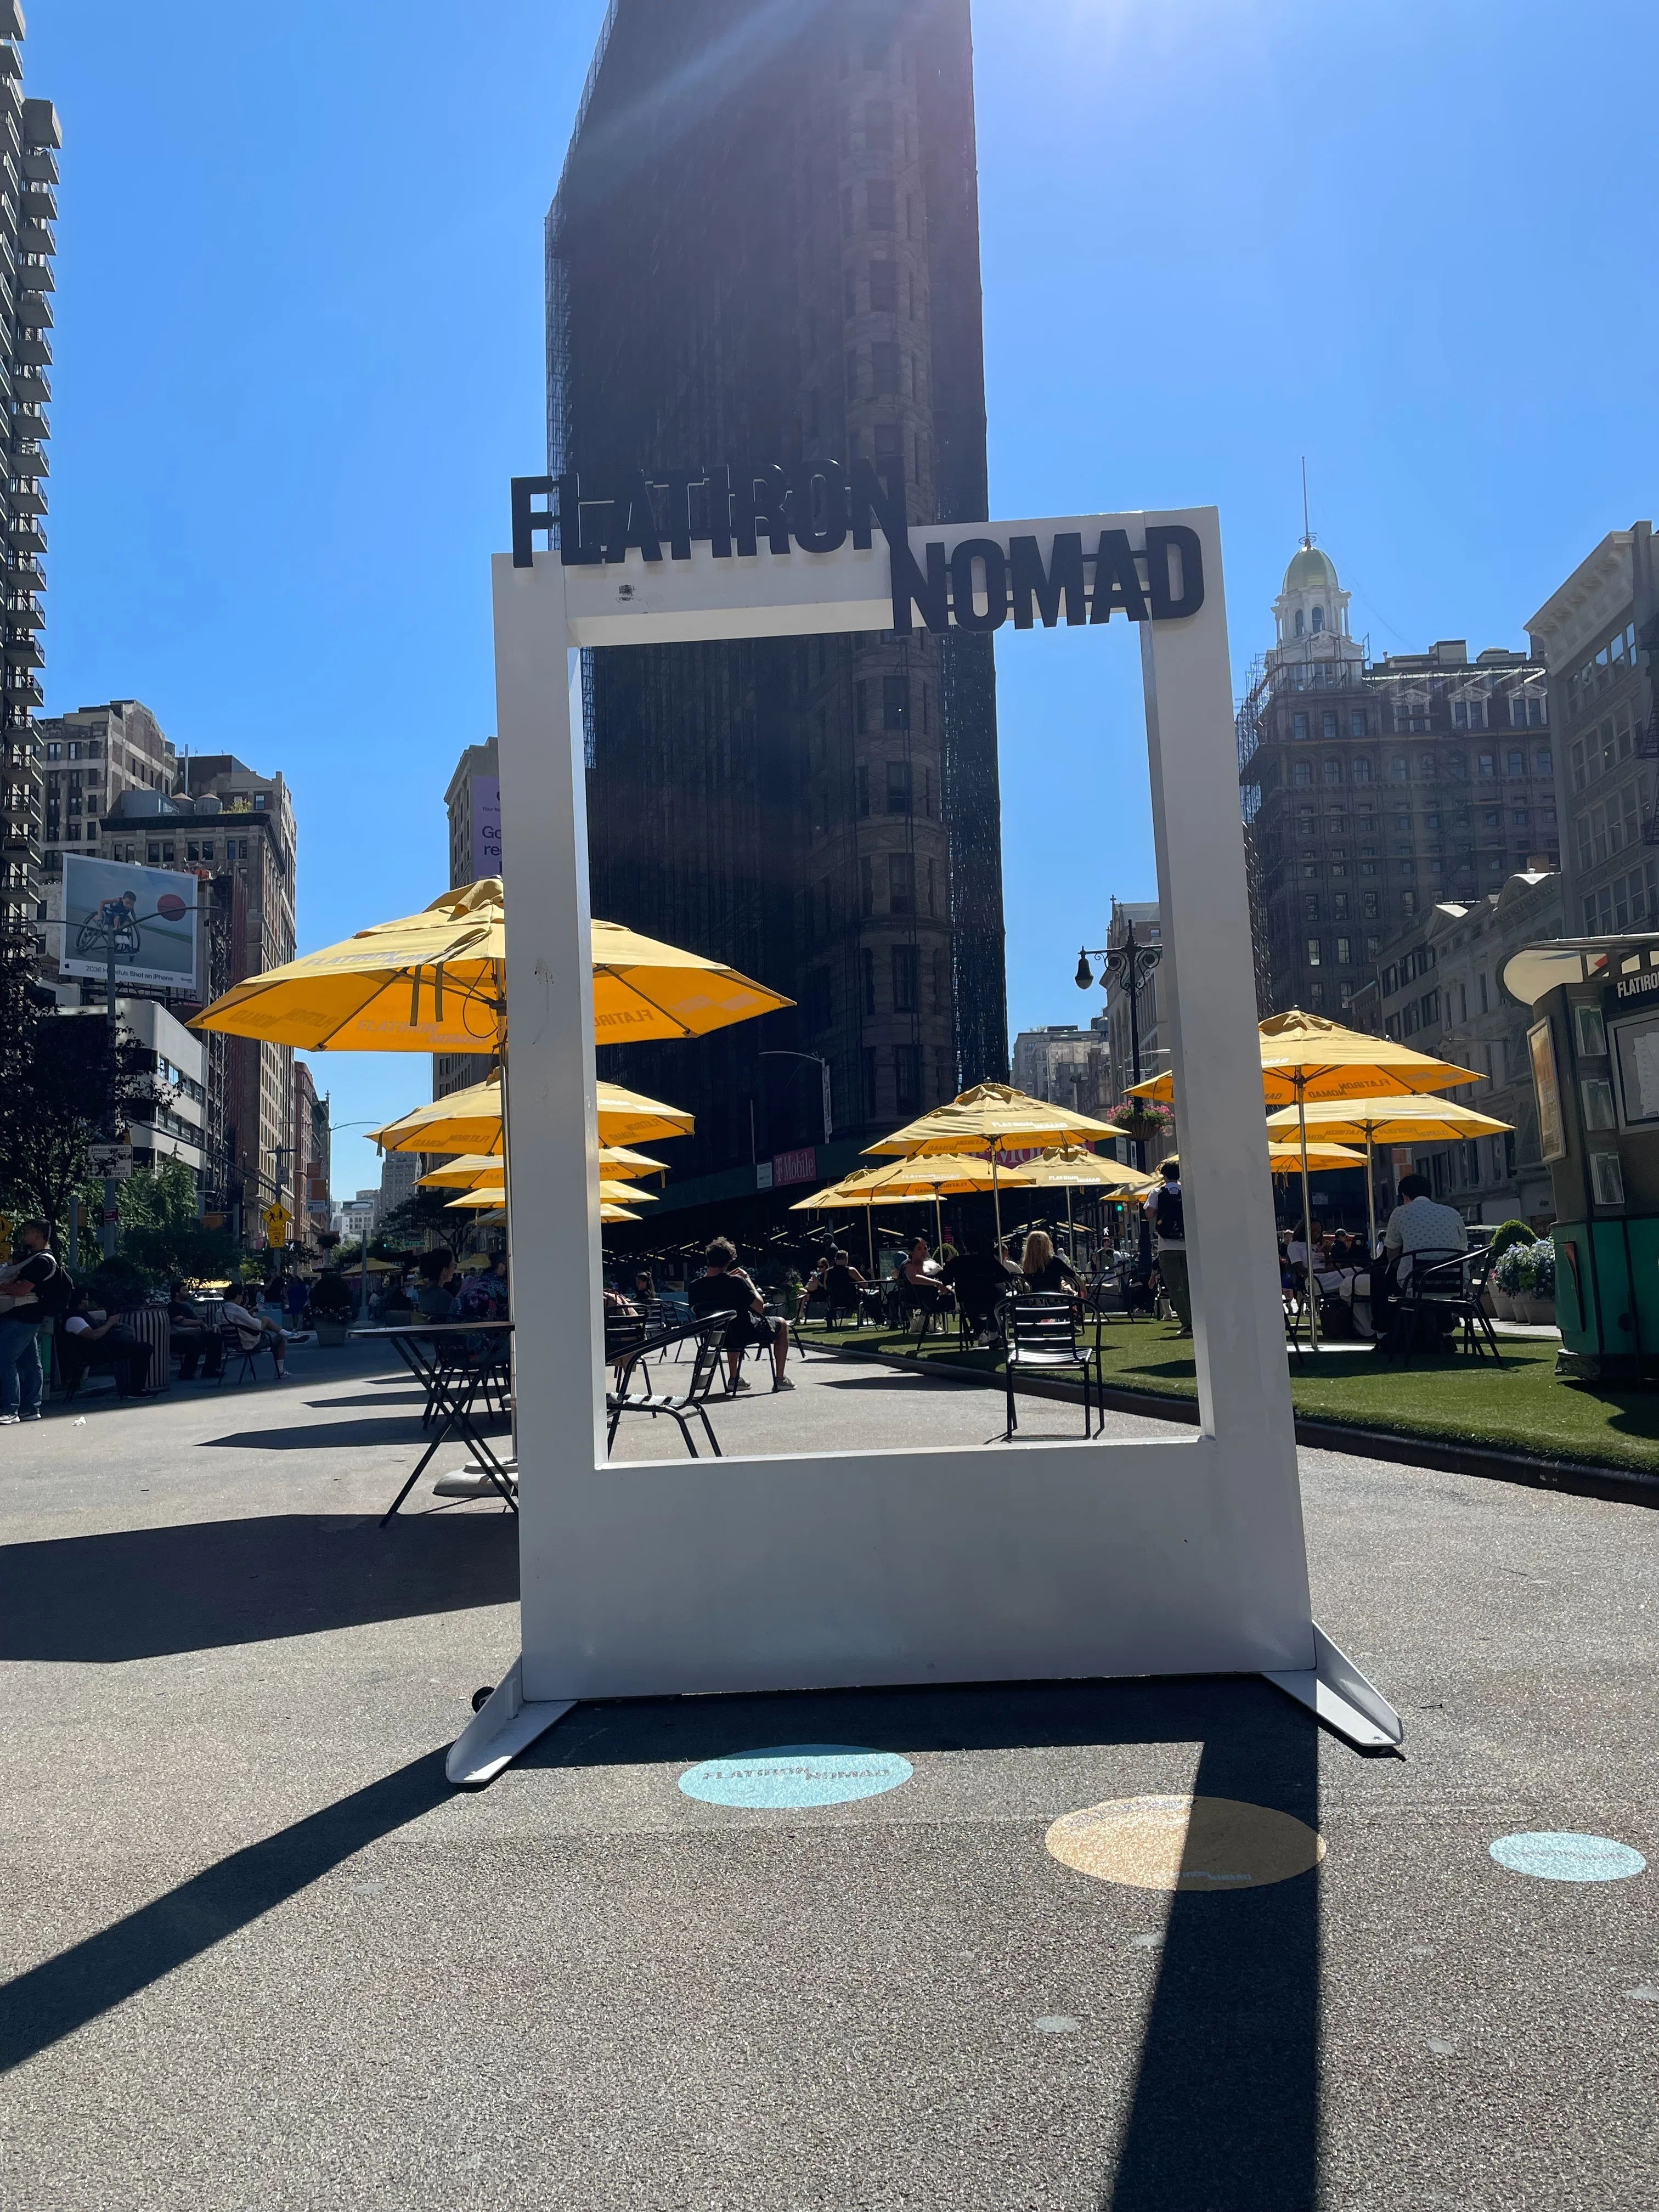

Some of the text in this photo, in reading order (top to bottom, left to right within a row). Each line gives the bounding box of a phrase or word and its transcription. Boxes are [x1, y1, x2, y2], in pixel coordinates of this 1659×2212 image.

[510, 455, 908, 568] FLATIRON
[890, 525, 1205, 636] NOMAD
[1617, 971, 1659, 998] FLATIRO
